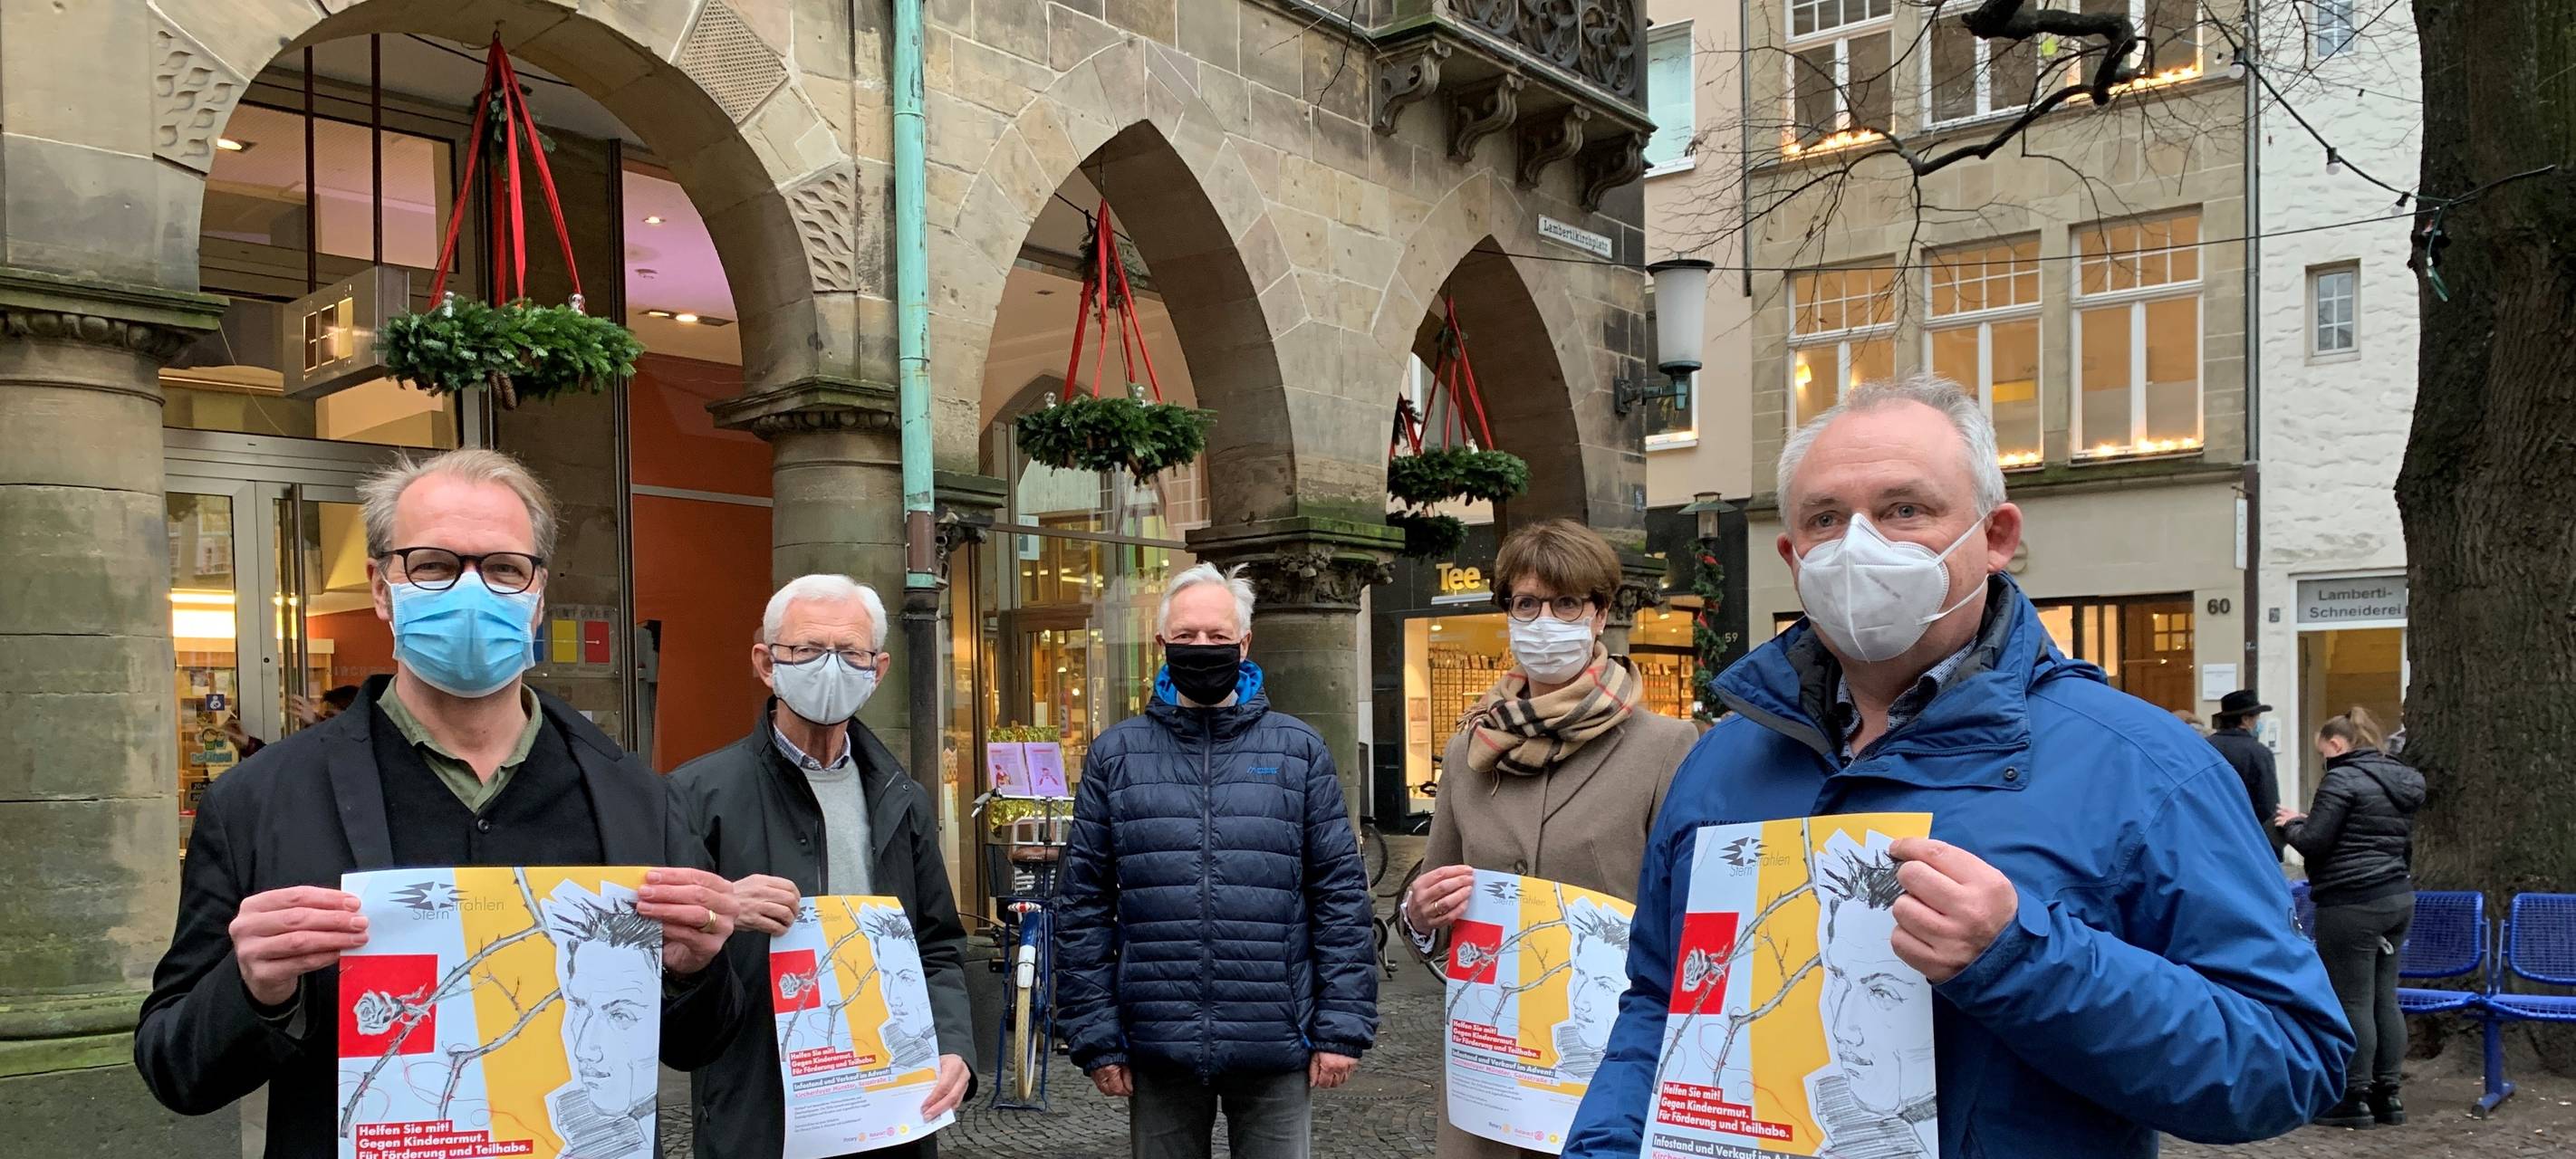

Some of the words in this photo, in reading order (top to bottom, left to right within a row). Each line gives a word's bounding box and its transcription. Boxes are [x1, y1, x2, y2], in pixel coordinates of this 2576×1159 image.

[1436, 562, 1481, 590] Tee
[2319, 587, 2393, 601] Lamberti-
[2207, 598, 2231, 615] 60
[2310, 603, 2402, 618] Schneiderei
[1725, 632, 1739, 643] 59
[412, 905, 449, 921] Stern
[1453, 1020, 1473, 1030] Helfen
[1453, 1029, 1472, 1038] Gegen
[1494, 1044, 1507, 1052] und
[1508, 1047, 1539, 1058] Teilhabe.
[1663, 1084, 1687, 1097] Helfen
[1688, 1087, 1702, 1098] Sie
[1703, 1089, 1721, 1101] mit!
[1661, 1097, 1686, 1111] Gegen
[1687, 1100, 1750, 1119] Kinderarmut.
[359, 1125, 402, 1136] Helfen
[404, 1123, 424, 1135] Sie
[426, 1122, 449, 1133] mit!
[1658, 1110, 1671, 1121] Für
[1672, 1112, 1716, 1130] Förderung
[1719, 1119, 1738, 1132] und
[1740, 1123, 1790, 1138] Teilhabe.
[359, 1138, 401, 1150] Gegen
[404, 1135, 485, 1148] Kinderarmut.
[1654, 1135, 1695, 1152] Infostand
[1696, 1142, 1715, 1155] und
[1716, 1145, 1757, 1159] Verkauf
[360, 1151, 379, 1159] Für
[381, 1148, 447, 1159] Förderung
[449, 1145, 473, 1156] und
[476, 1142, 530, 1154] Teilhabe.
